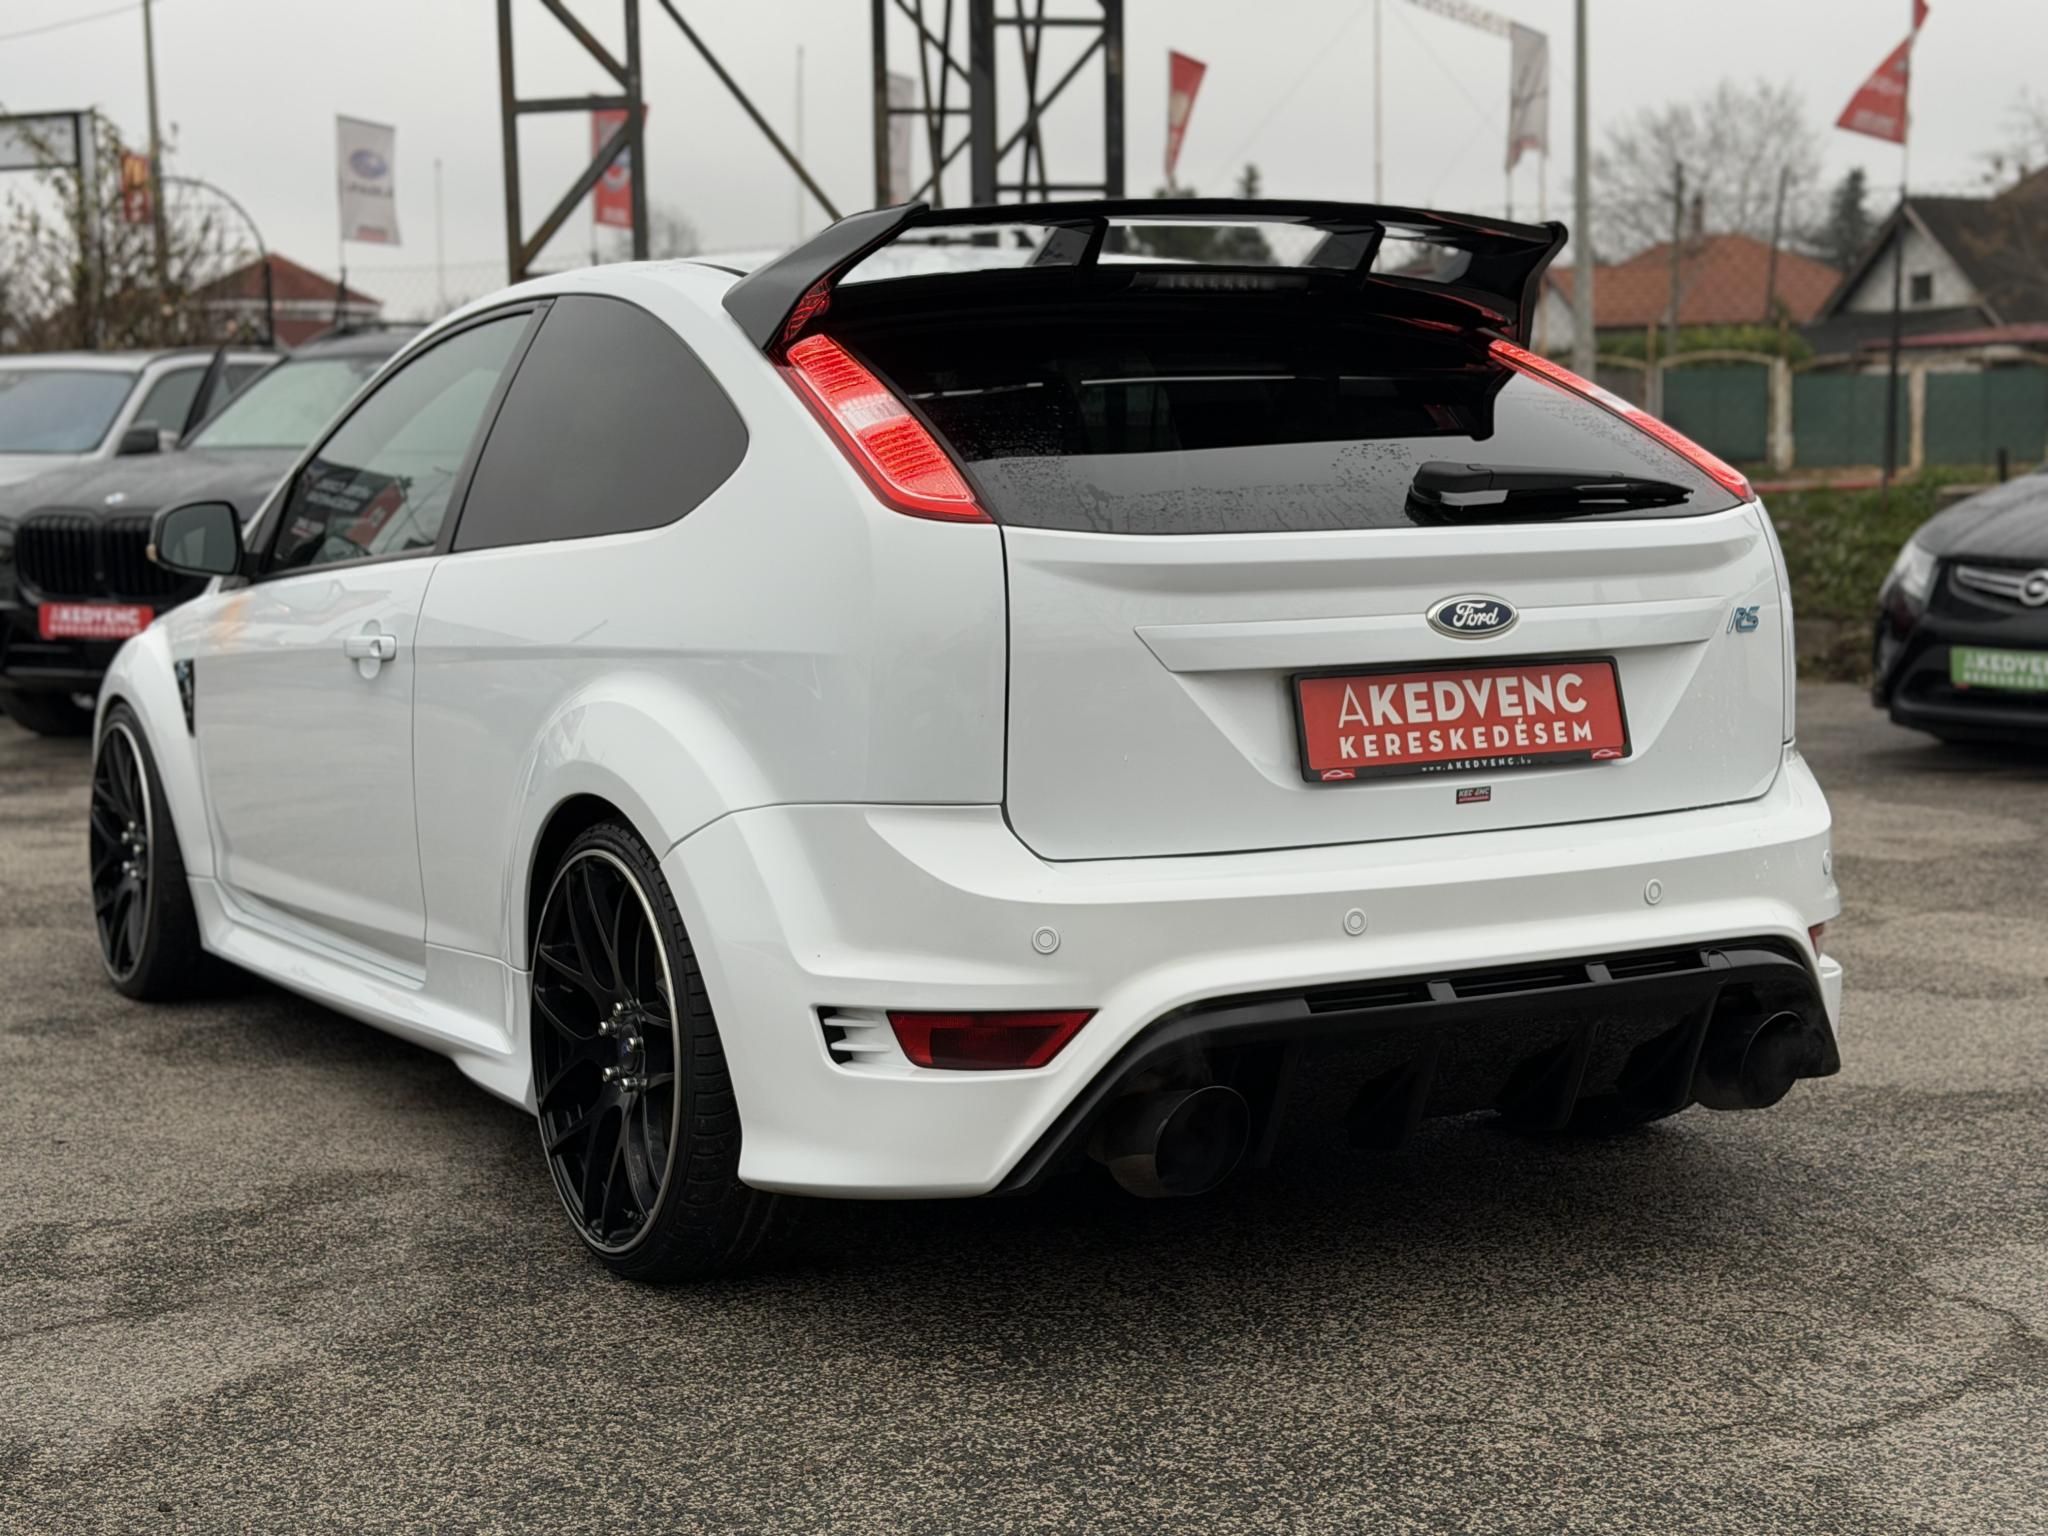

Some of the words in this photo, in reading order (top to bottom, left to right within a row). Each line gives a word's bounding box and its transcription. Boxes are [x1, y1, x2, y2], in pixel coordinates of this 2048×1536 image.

[1453, 602, 1499, 627] Ford
[1726, 605, 1761, 634] RS
[1339, 717, 1593, 760] KERESKEDÉSEM
